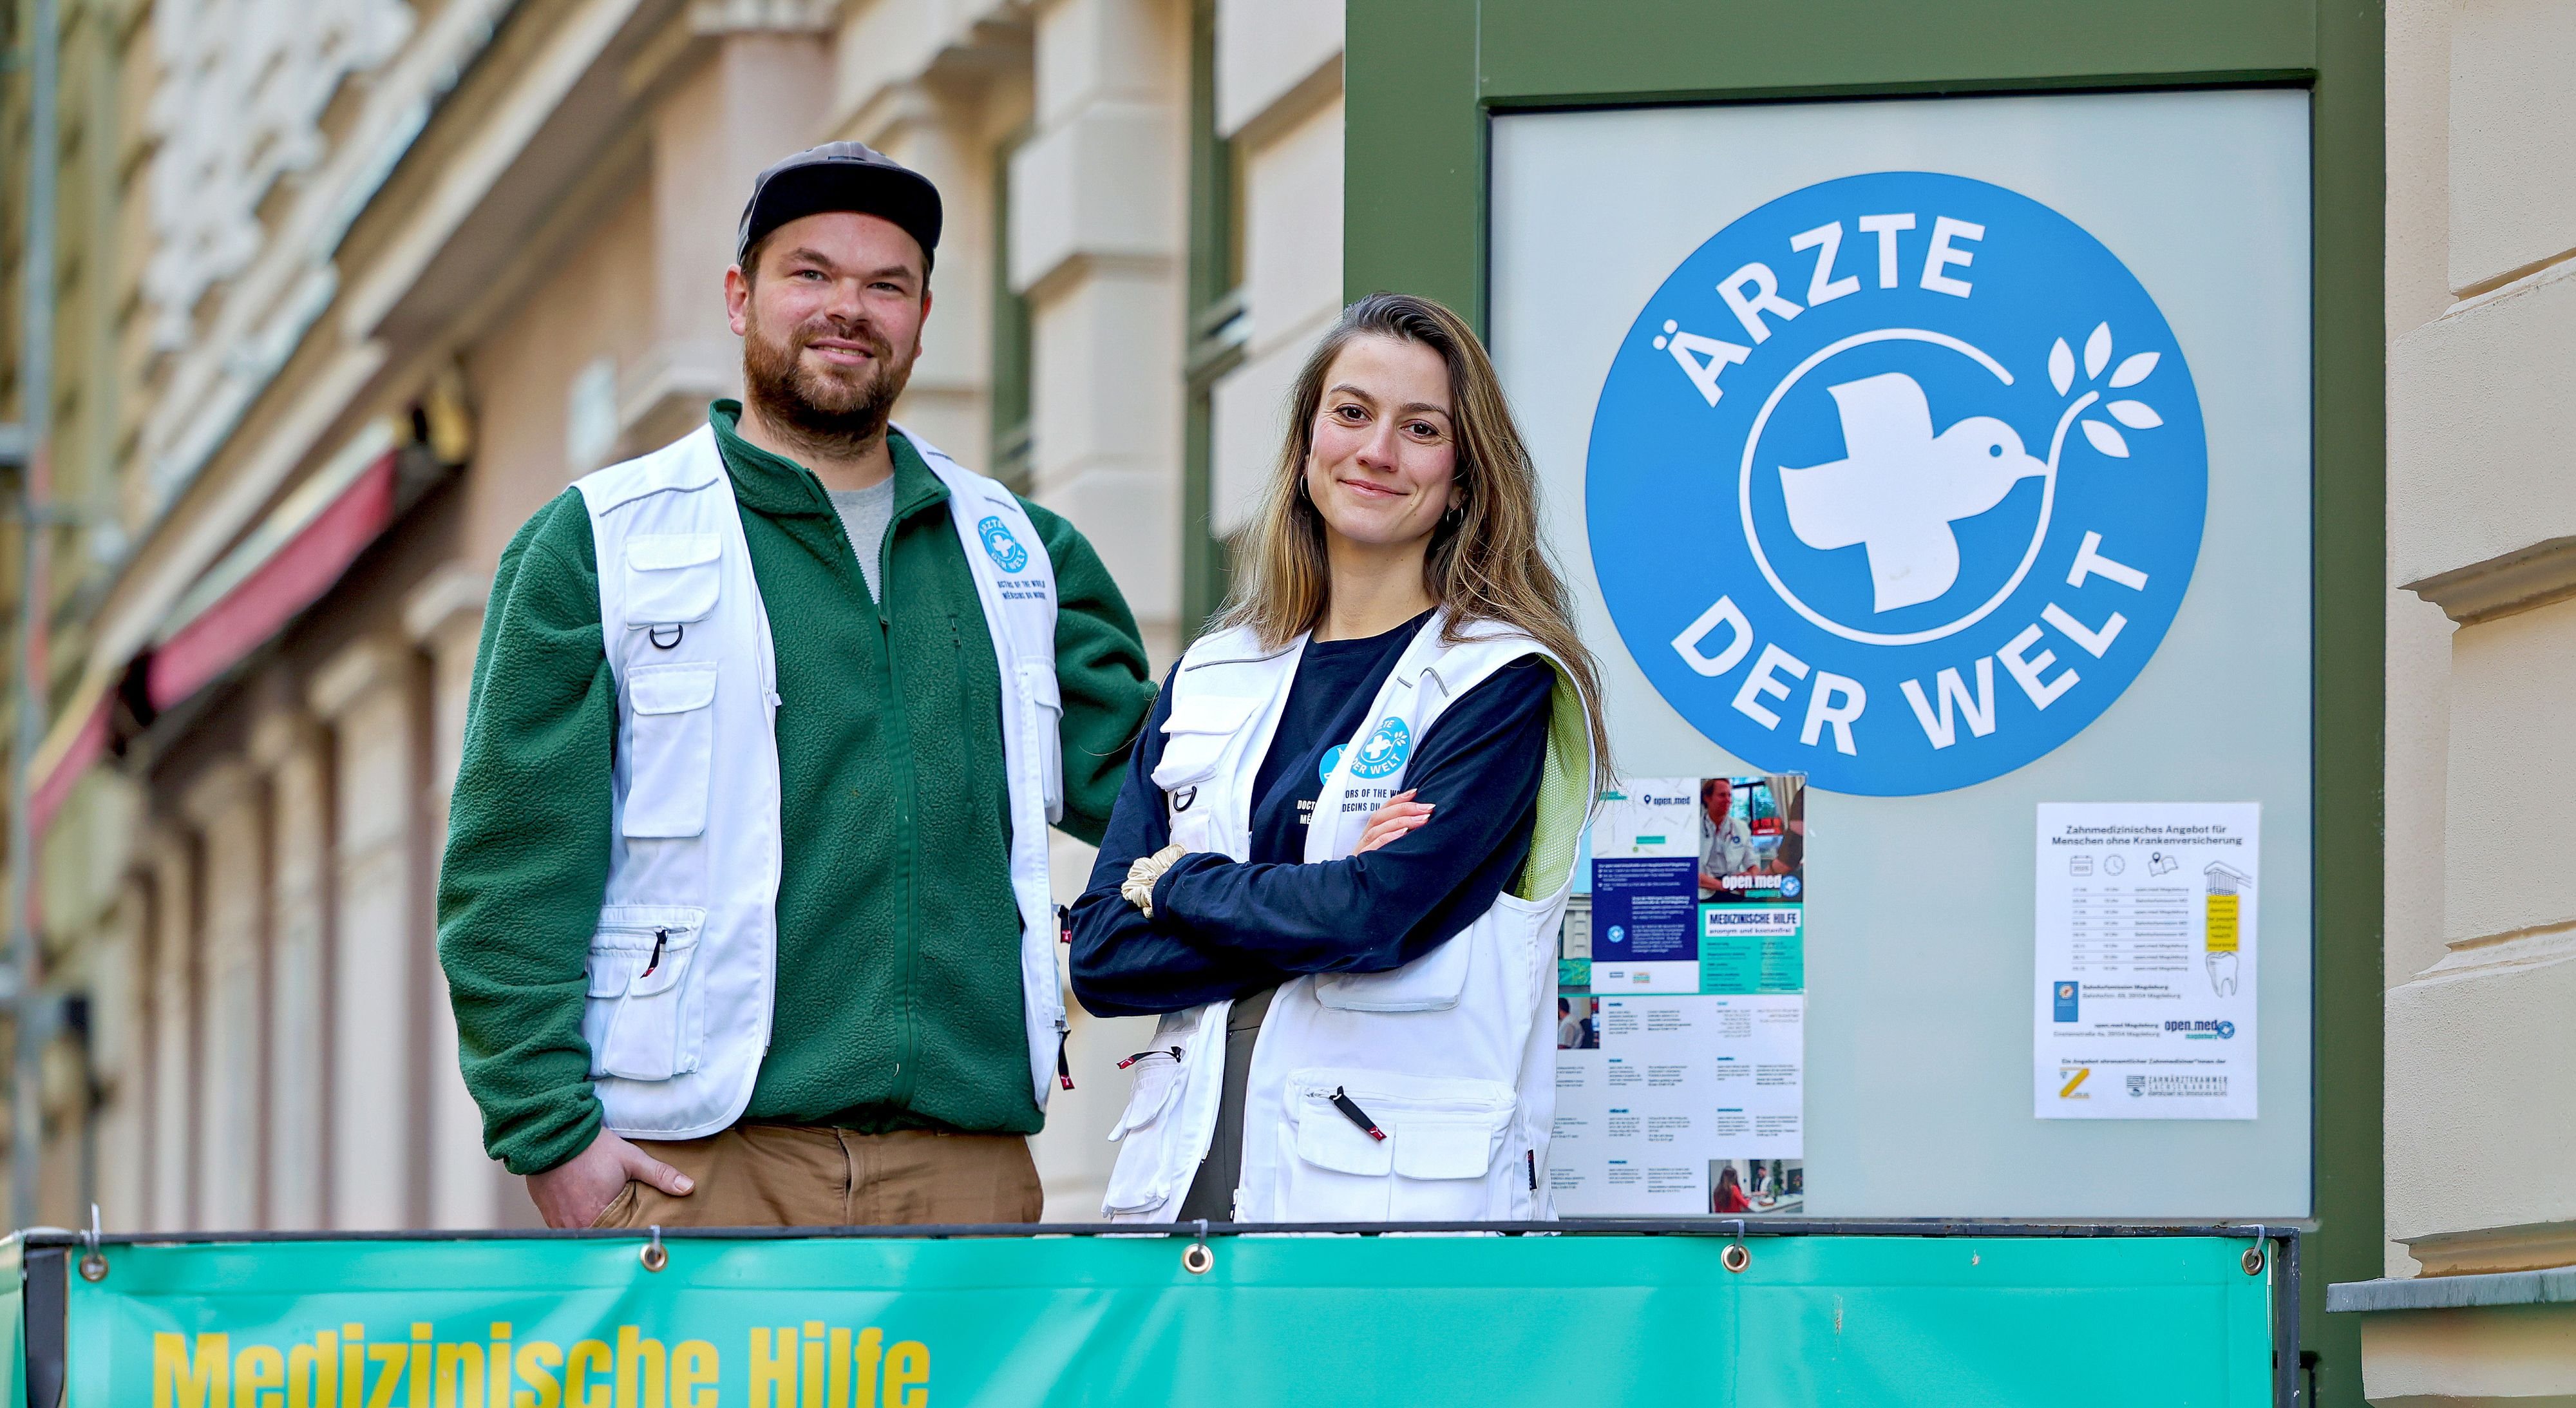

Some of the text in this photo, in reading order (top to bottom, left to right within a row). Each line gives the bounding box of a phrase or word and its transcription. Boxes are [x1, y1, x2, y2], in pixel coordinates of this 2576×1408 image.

[1653, 213, 1985, 408] ÄRZTE
[1671, 530, 2149, 756] DER WELT
[1370, 753, 1401, 774] WELT
[1361, 788, 1370, 797] OF
[1374, 788, 1387, 798] THE
[2066, 824, 2227, 835] Zahnmedizinisches Angebot für
[2052, 837, 2243, 846] Menschen ohne Krankenversicherung
[1709, 913, 1797, 924] MEDIZINISCHE HILFE
[153, 1321, 931, 1408] Medizinische Hilfe
